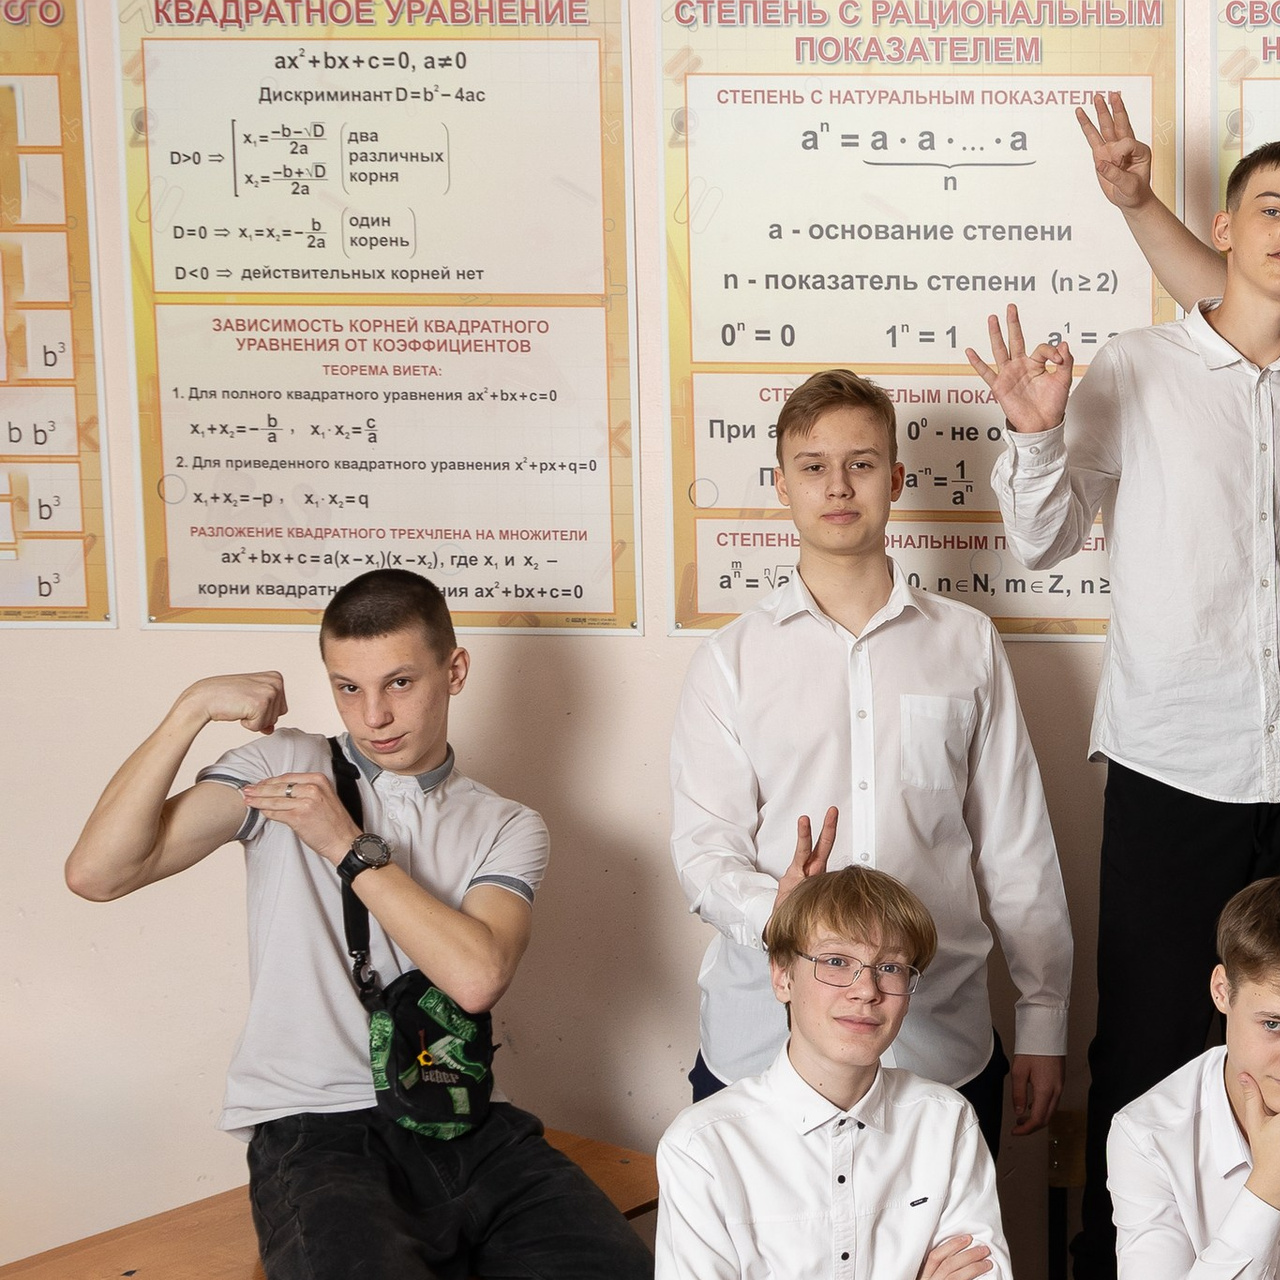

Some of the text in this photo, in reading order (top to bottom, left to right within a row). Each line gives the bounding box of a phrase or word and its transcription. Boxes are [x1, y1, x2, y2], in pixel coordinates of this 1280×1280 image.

[793, 35, 1041, 64] ПОКАЗАТЕЛЕМ
[258, 86, 393, 106] Дискриминант
[716, 89, 805, 105] СТЕПЕНЬ
[810, 89, 823, 105] С
[829, 89, 975, 105] НАТУРАЛЬНЫМ
[347, 131, 379, 145] два
[170, 151, 201, 166] D>0
[349, 151, 444, 166] различных
[349, 171, 399, 186] корня
[943, 175, 957, 191] n
[349, 216, 391, 229] один
[173, 225, 208, 240] D=0
[768, 223, 1072, 242] a основание степени
[350, 236, 410, 250] корень
[175, 265, 485, 283] D<0 действительных корней нет
[723, 273, 739, 290] n
[765, 273, 918, 291] показатель
[927, 274, 1036, 292] степени
[212, 316, 550, 336] ЗАВИСИМОСТЬ КОРНЕЙ КВАДРАТНОГО
[780, 324, 796, 347] 0
[945, 325, 957, 349] 1
[235, 337, 532, 355] УРАВНЕНИЯ ОТ КОЭФФИЦИЕНТОВ
[322, 364, 442, 377] ТЕОРЕМА ВИЕТА:
[172, 386, 185, 399] 1.
[188, 386, 217, 401] Для
[221, 390, 282, 400] полного
[286, 390, 379, 403] квадратного
[382, 391, 463, 404] уравнения
[709, 419, 756, 444] При
[951, 426, 979, 442] не
[175, 455, 188, 468] 2.
[192, 455, 221, 470] Для
[225, 459, 330, 472] приведенного
[334, 460, 427, 473] квадратного
[430, 461, 510, 474] уравнения
[190, 526, 588, 541] РАЗЛОЖЕНИЕ КВАДРАТНОГО ТРЕХЧЛЕНА НА МНОЖИТЕЛИ
[450, 555, 479, 569] где
[504, 555, 515, 567] и
[198, 583, 250, 598] корни
